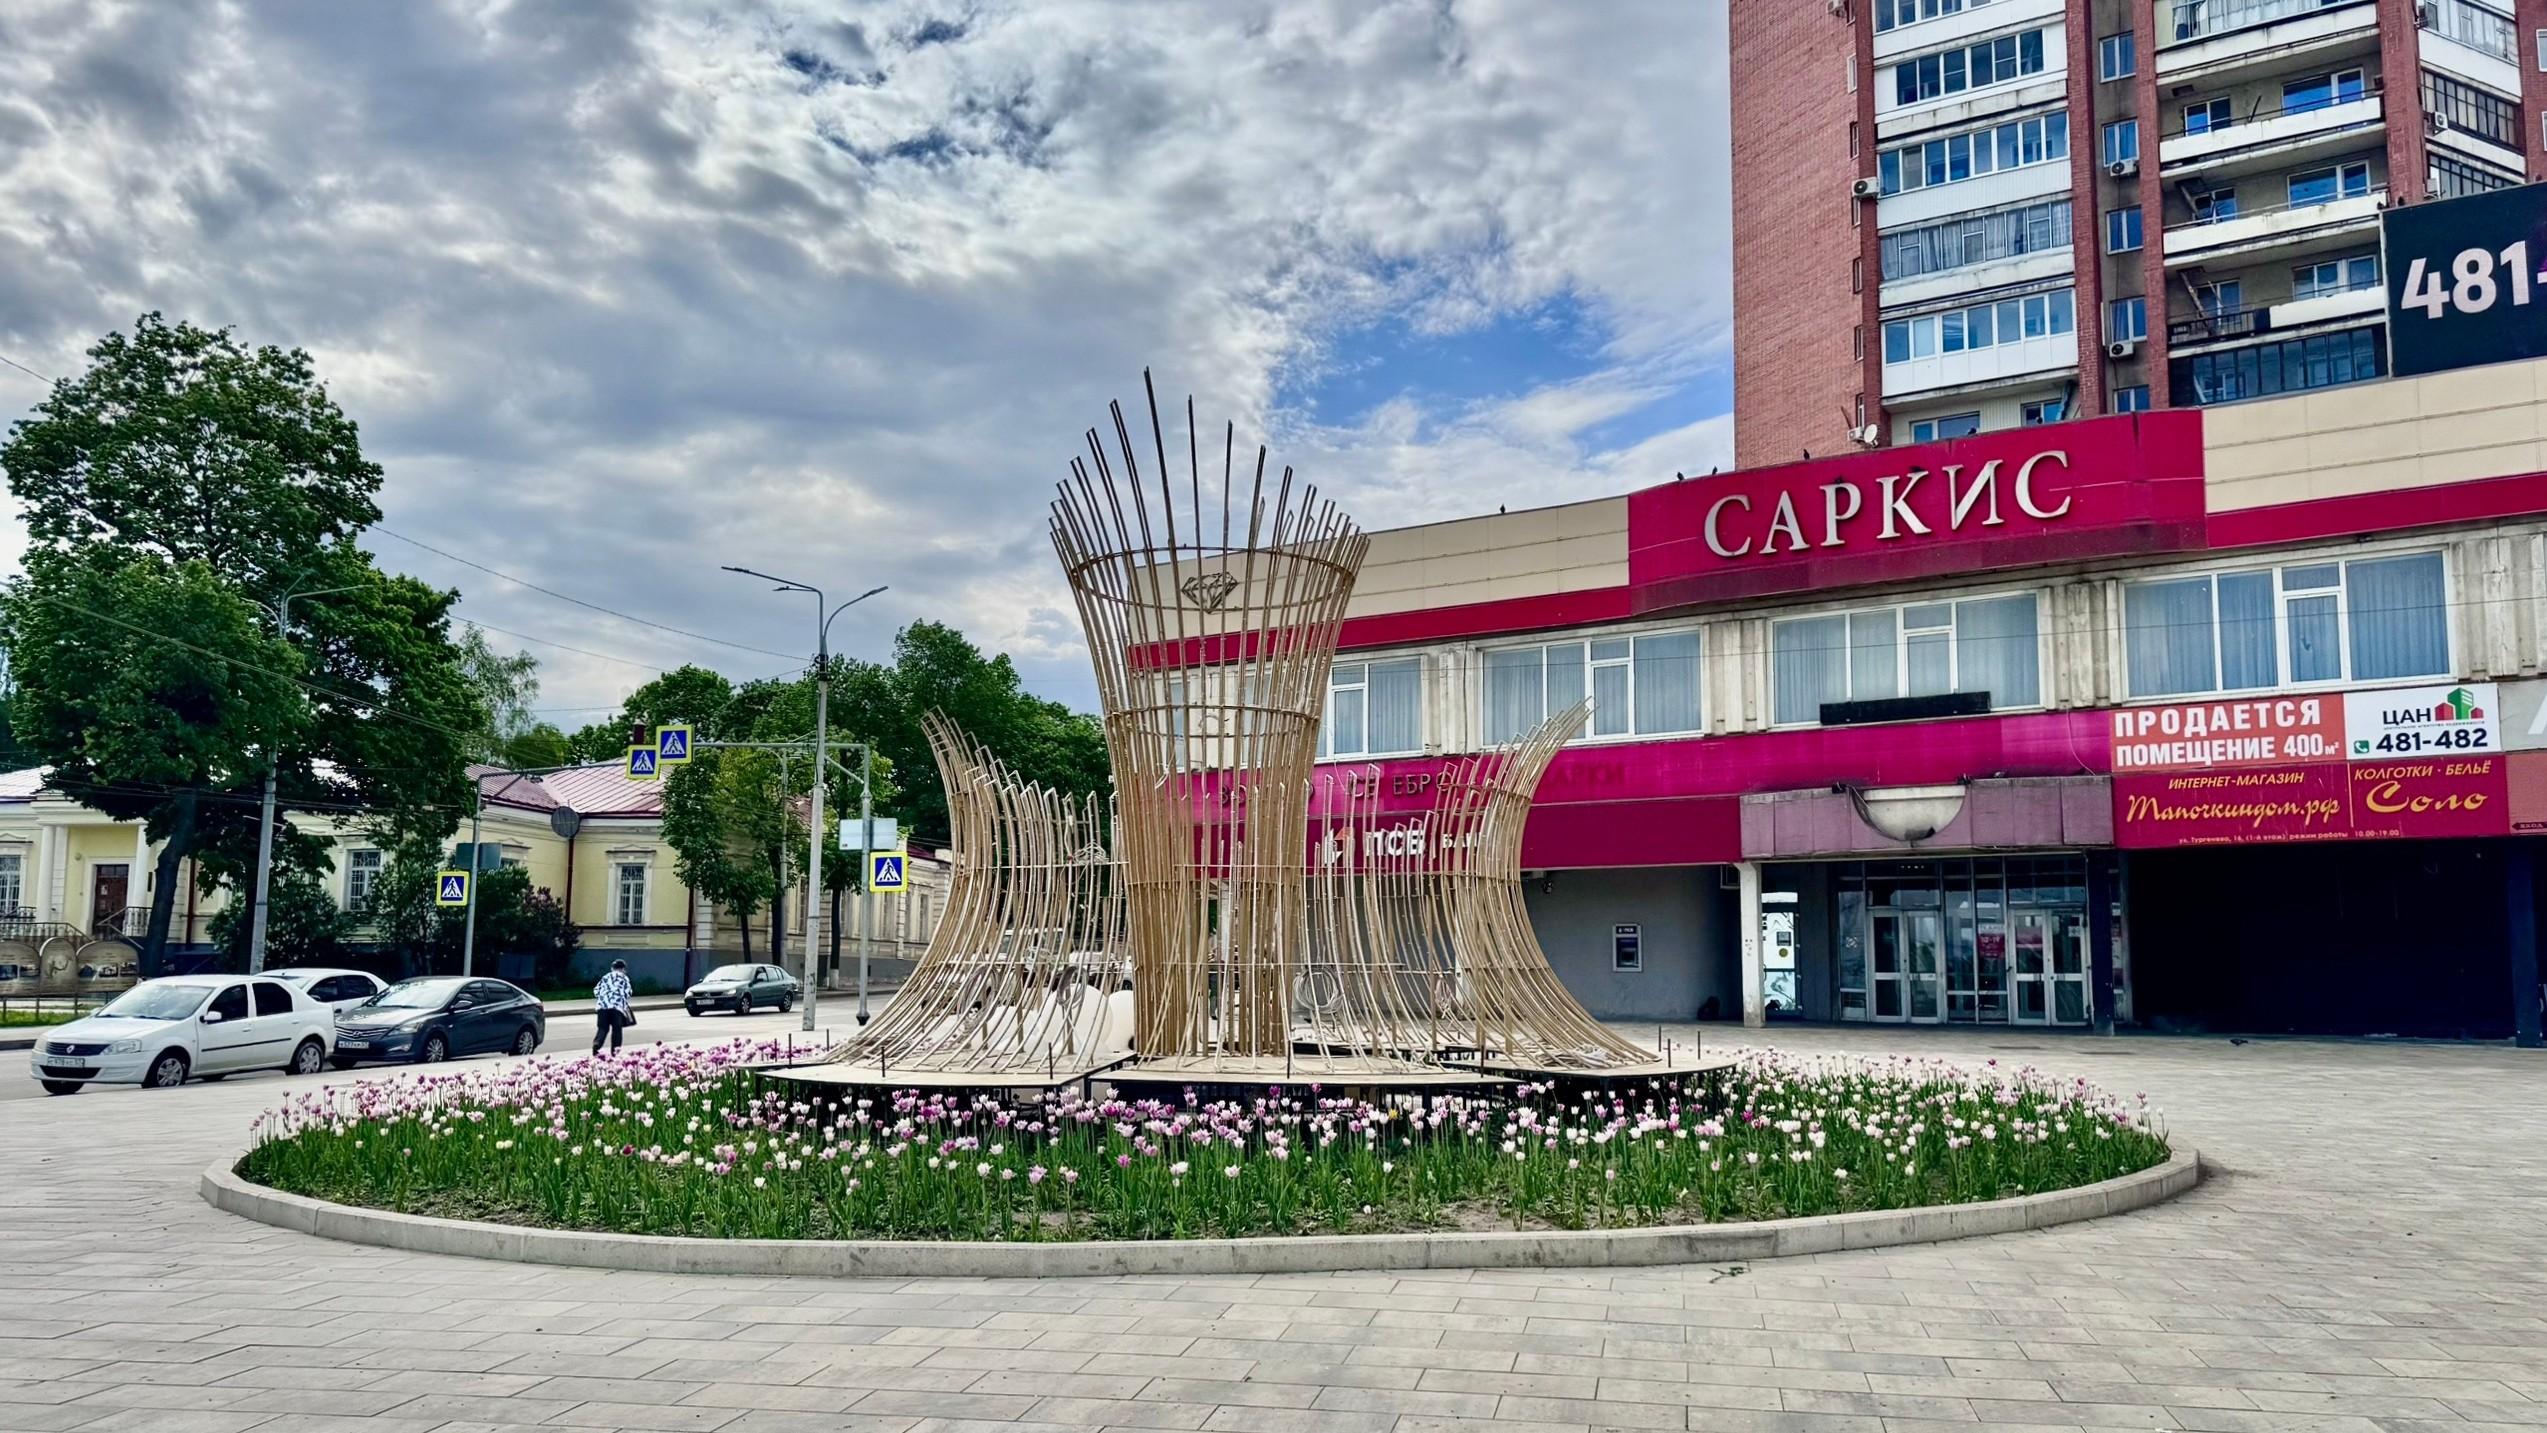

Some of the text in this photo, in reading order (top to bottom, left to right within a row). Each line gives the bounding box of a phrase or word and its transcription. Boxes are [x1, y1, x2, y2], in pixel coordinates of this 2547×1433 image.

[1703, 450, 2071, 557] САРКИС
[2114, 699, 2321, 738] ПРОДАЕТСЯ
[2382, 707, 2431, 726] ЦАН
[2116, 736, 2276, 767] ПОМЕЩЕНИЕ
[2376, 728, 2488, 752] 481-482
[2168, 772, 2305, 790] ИНТЕРНЕТ-МАГАЗИН
[2354, 760, 2492, 780] КОЛГОТКИ БЕЛЬЁ
[2126, 794, 2341, 828] Тапочкиндом.рф
[2366, 780, 2489, 813] Соло
